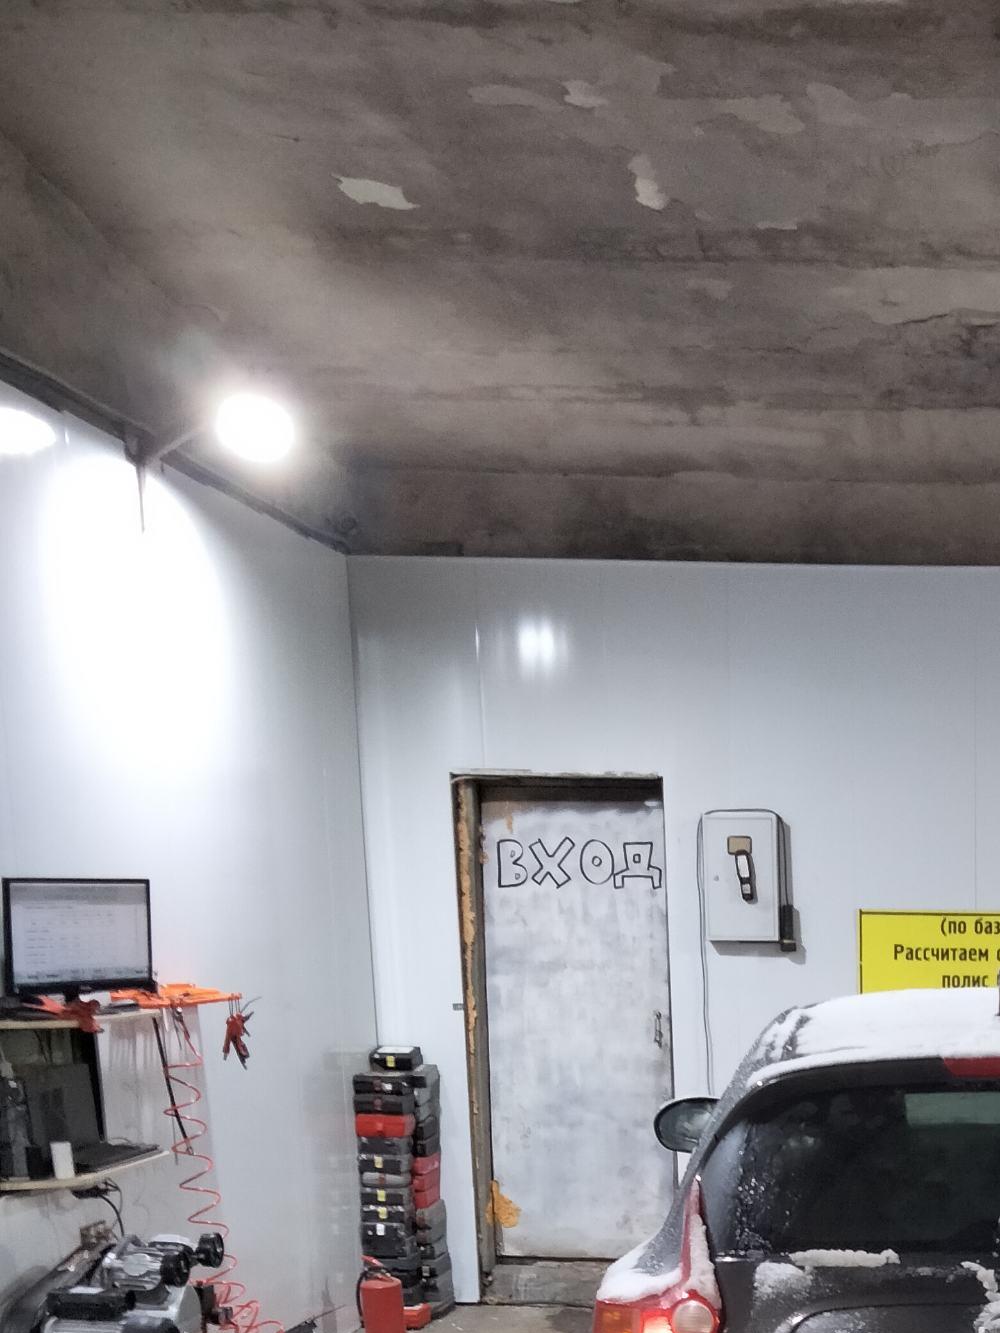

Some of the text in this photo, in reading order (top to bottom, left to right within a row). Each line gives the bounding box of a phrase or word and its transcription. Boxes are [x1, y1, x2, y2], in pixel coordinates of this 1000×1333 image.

[496, 836, 663, 889] ВХОД
[940, 917, 967, 937] (по
[893, 944, 989, 962] Рассчитаем
[942, 974, 989, 988] полис
